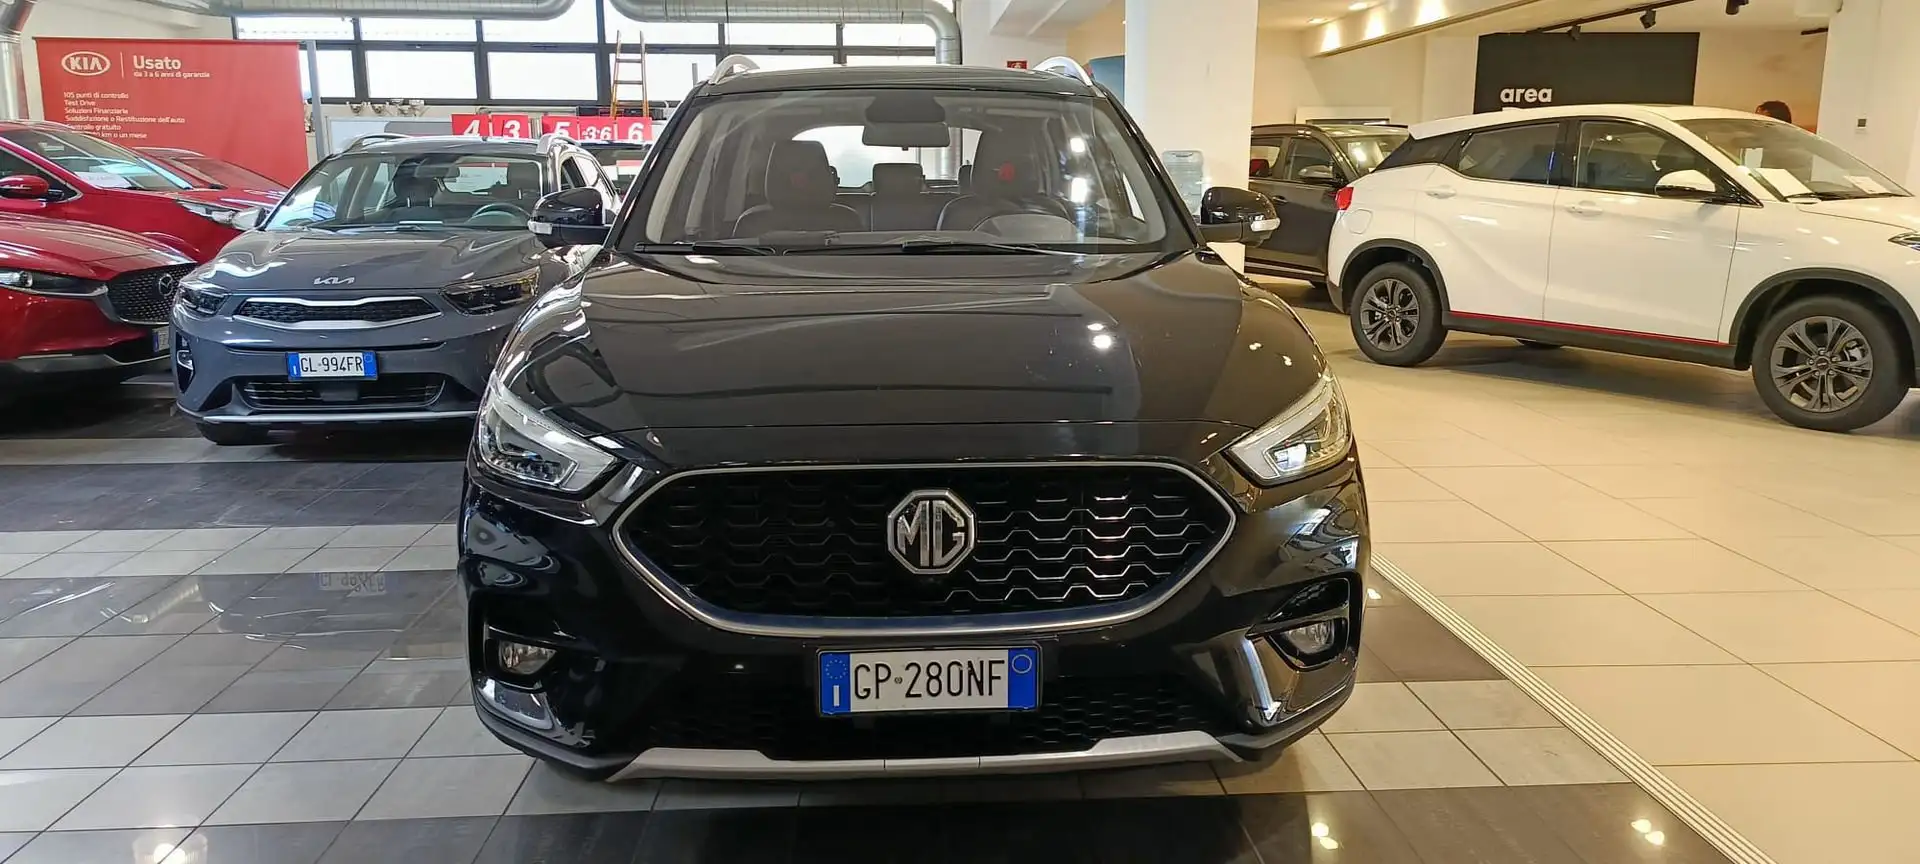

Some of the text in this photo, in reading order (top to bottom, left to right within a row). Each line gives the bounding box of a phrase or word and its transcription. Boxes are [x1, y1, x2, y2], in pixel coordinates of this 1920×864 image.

[133, 55, 182, 70] Usato
[76, 92, 92, 100] punti
[1500, 87, 1552, 103] area
[627, 122, 644, 141] 6
[300, 357, 317, 373] GL
[321, 356, 363, 372] 994FR
[897, 500, 965, 567] MG
[854, 663, 892, 700] GP
[905, 660, 1005, 698] 280NF
